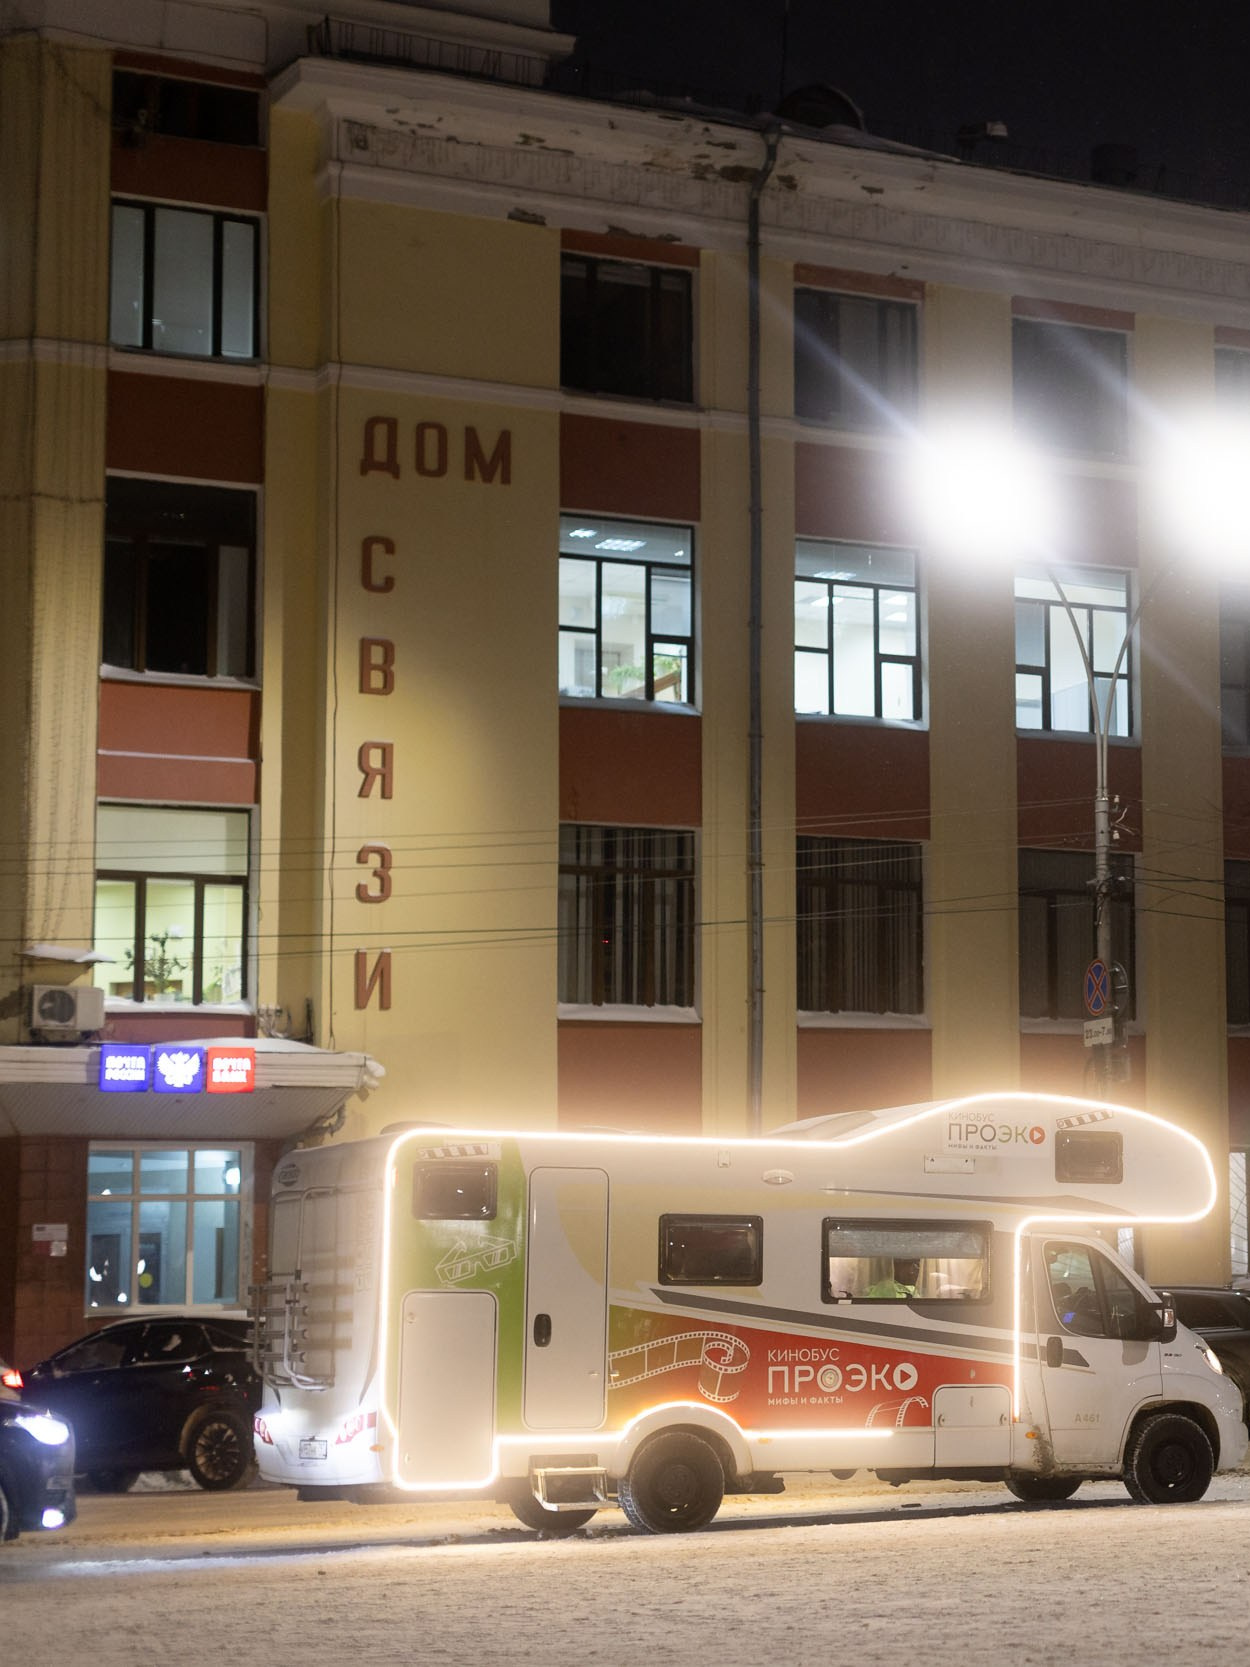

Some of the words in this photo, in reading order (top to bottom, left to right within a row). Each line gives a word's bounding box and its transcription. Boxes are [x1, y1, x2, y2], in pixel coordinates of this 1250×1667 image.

[360, 416, 512, 485] ДОМ
[354, 535, 396, 1011] СВЯЗИ
[948, 1112, 995, 1123] КИНОБУС
[768, 1348, 840, 1362] КИНОБУС
[768, 1362, 918, 1393] ПРОЭКО
[768, 1397, 798, 1406] МИФЫ
[800, 1396, 807, 1405] И
[810, 1395, 843, 1405] ФАКТЫ
